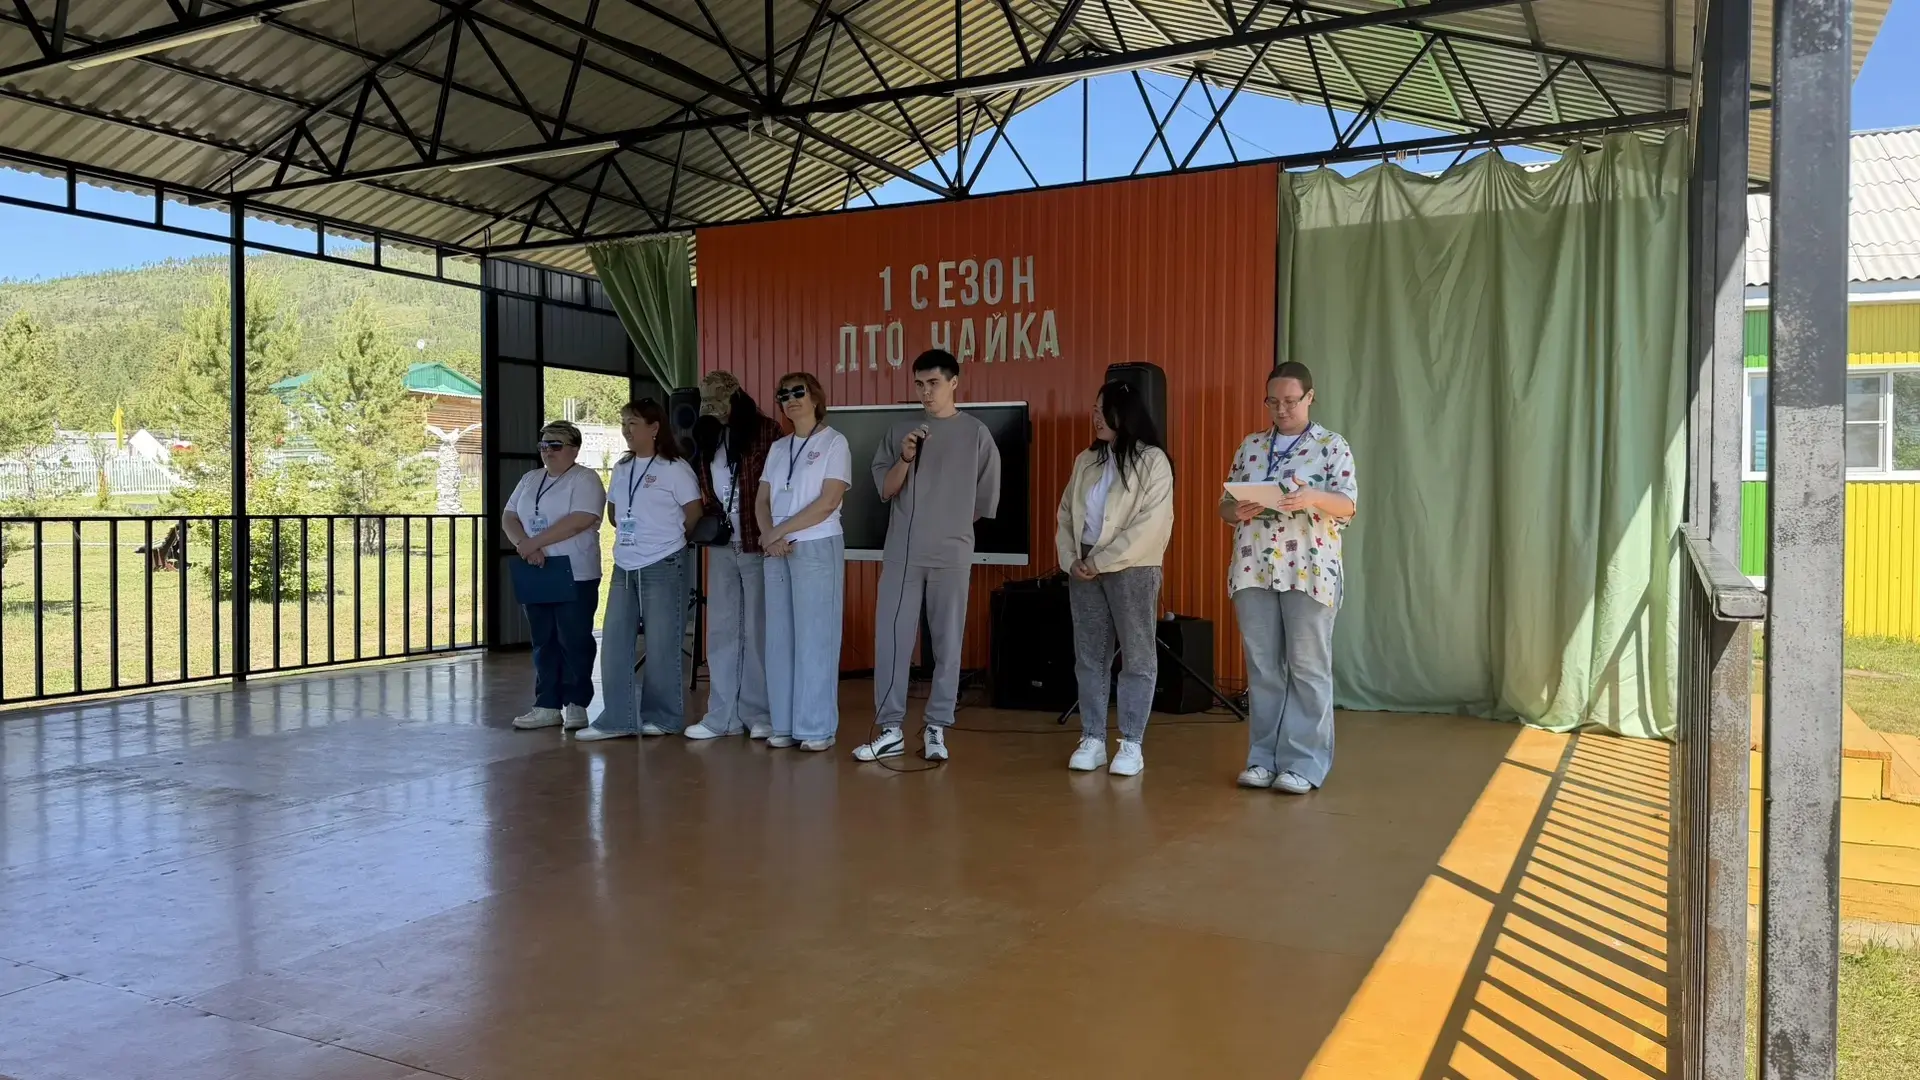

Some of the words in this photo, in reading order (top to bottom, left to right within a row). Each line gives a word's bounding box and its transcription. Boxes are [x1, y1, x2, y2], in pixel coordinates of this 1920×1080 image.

[879, 266, 892, 311] 1
[910, 255, 1035, 310] СЕЗОН
[931, 310, 1060, 364] ЧАЙКА
